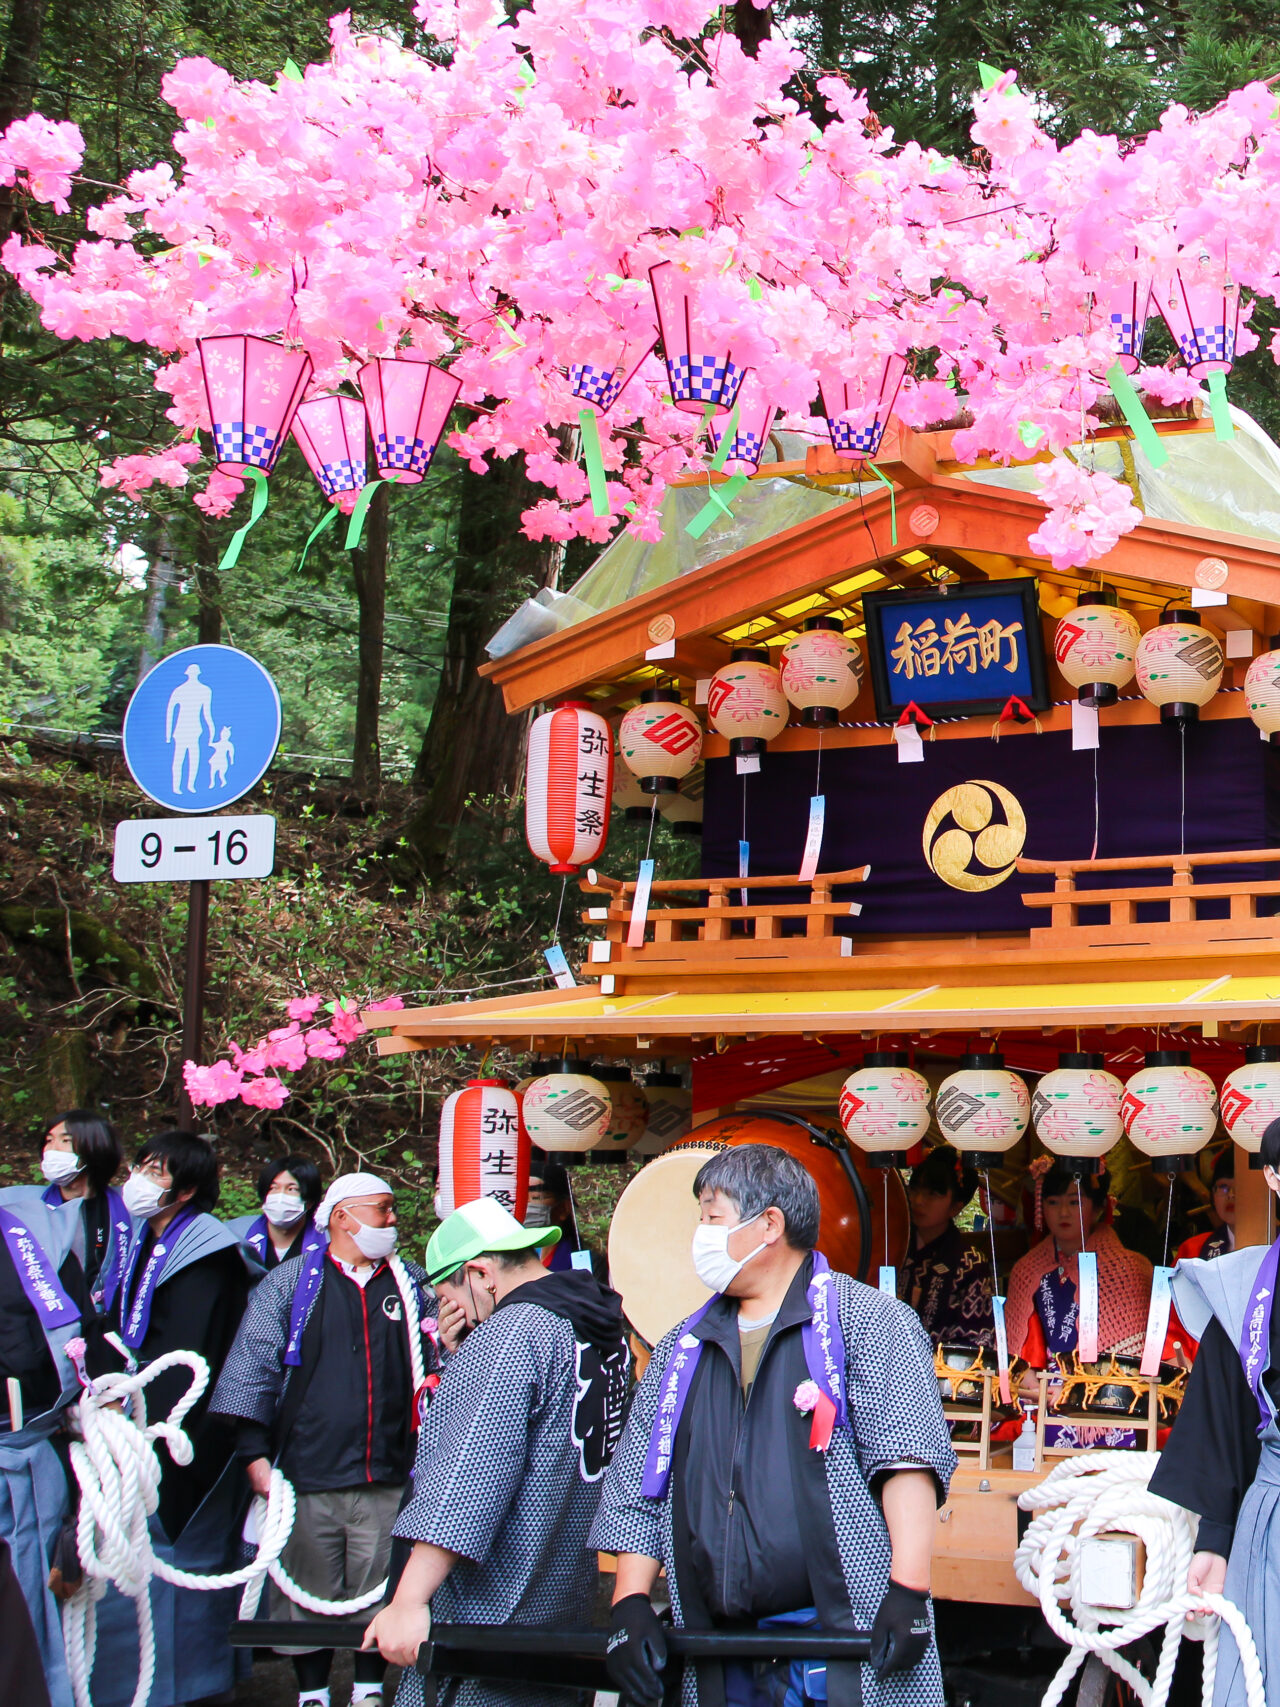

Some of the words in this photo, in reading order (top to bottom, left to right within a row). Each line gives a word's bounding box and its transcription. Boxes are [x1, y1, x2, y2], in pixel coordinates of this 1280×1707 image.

[891, 612, 1023, 679] 稲荷町
[574, 727, 609, 836] 弥生祭
[16, 1237, 64, 1312] 弥生祭当番町
